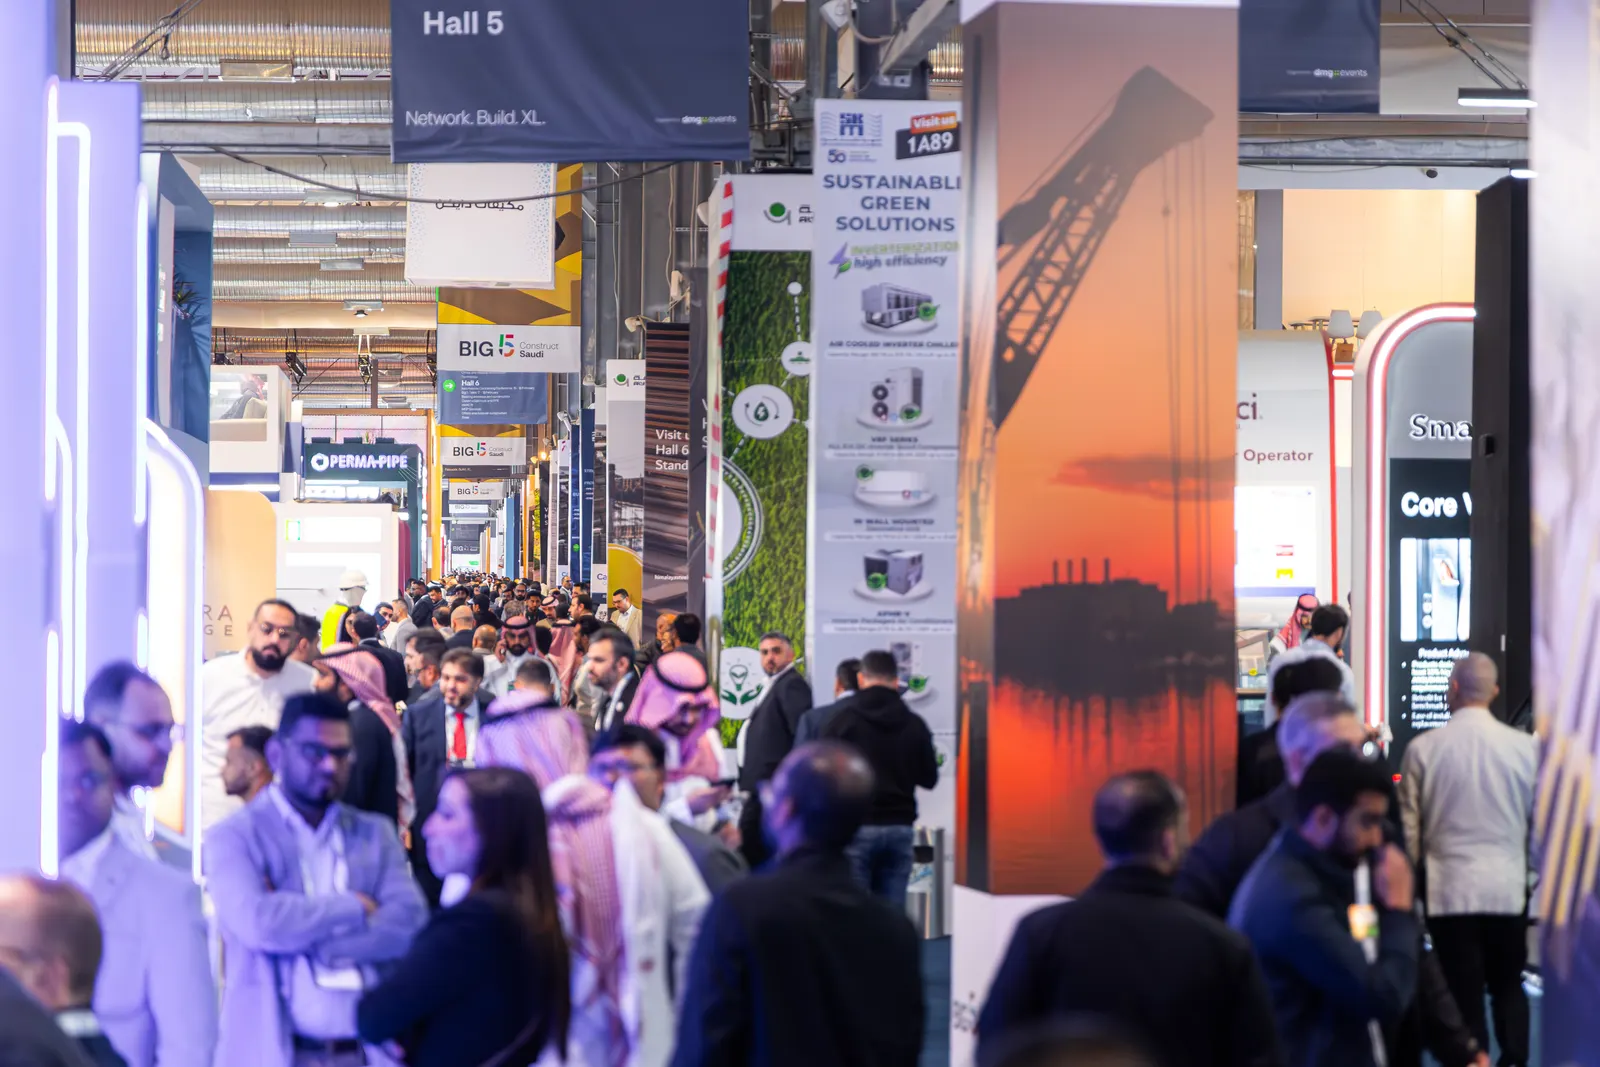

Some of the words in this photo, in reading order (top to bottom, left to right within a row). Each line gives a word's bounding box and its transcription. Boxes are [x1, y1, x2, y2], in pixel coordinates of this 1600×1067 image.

[423, 11, 478, 35] Hall
[487, 11, 504, 35] 5
[405, 110, 473, 126] Network.
[476, 110, 518, 126] Build.
[521, 110, 546, 125] XL.
[914, 116, 939, 128] Visit
[941, 115, 956, 126] us
[907, 131, 953, 154] 1A89
[860, 196, 931, 211] GREEN
[836, 216, 955, 232] SOLUTIONS
[459, 341, 493, 357] BIG
[519, 341, 559, 350] Construct
[655, 429, 682, 440] Visit
[453, 447, 474, 457] BIG
[655, 444, 678, 455] Hall
[681, 445, 689, 455] 6
[1243, 449, 1313, 464] Operator
[330, 454, 408, 469] PERMA-PIPE
[655, 459, 689, 470] Stand
[1401, 491, 1458, 518] Core
